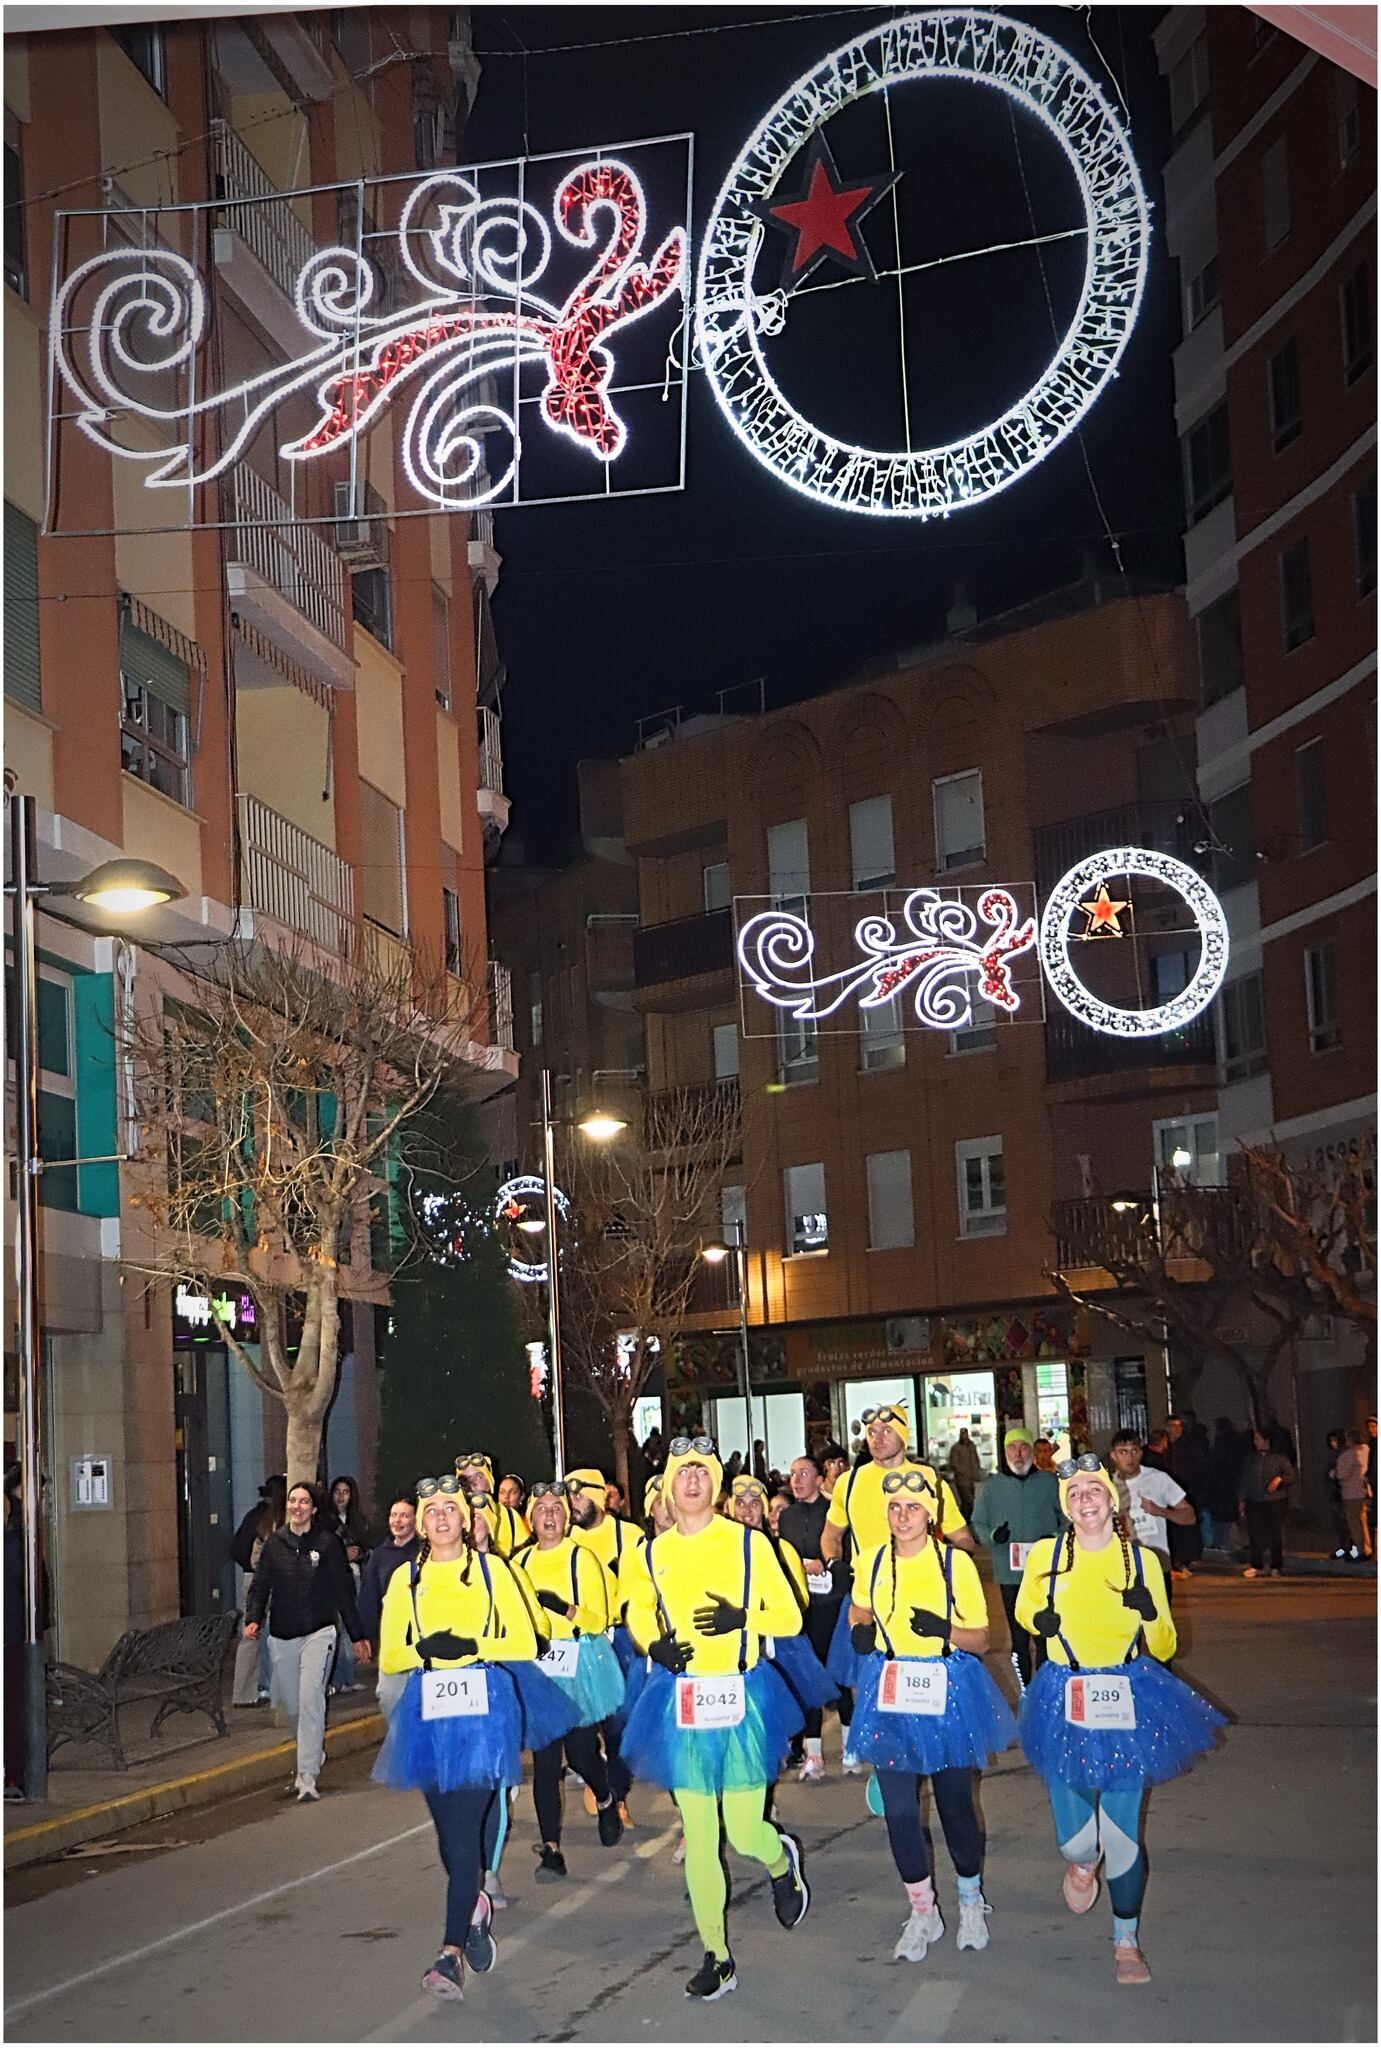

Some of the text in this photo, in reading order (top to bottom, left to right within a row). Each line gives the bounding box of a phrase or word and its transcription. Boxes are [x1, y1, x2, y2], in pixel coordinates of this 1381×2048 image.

[851, 1360, 863, 1371] de
[906, 1677, 931, 1688] 188
[436, 1680, 469, 1698] 201
[696, 1693, 737, 1706] 2042
[1092, 1690, 1120, 1702] 289
